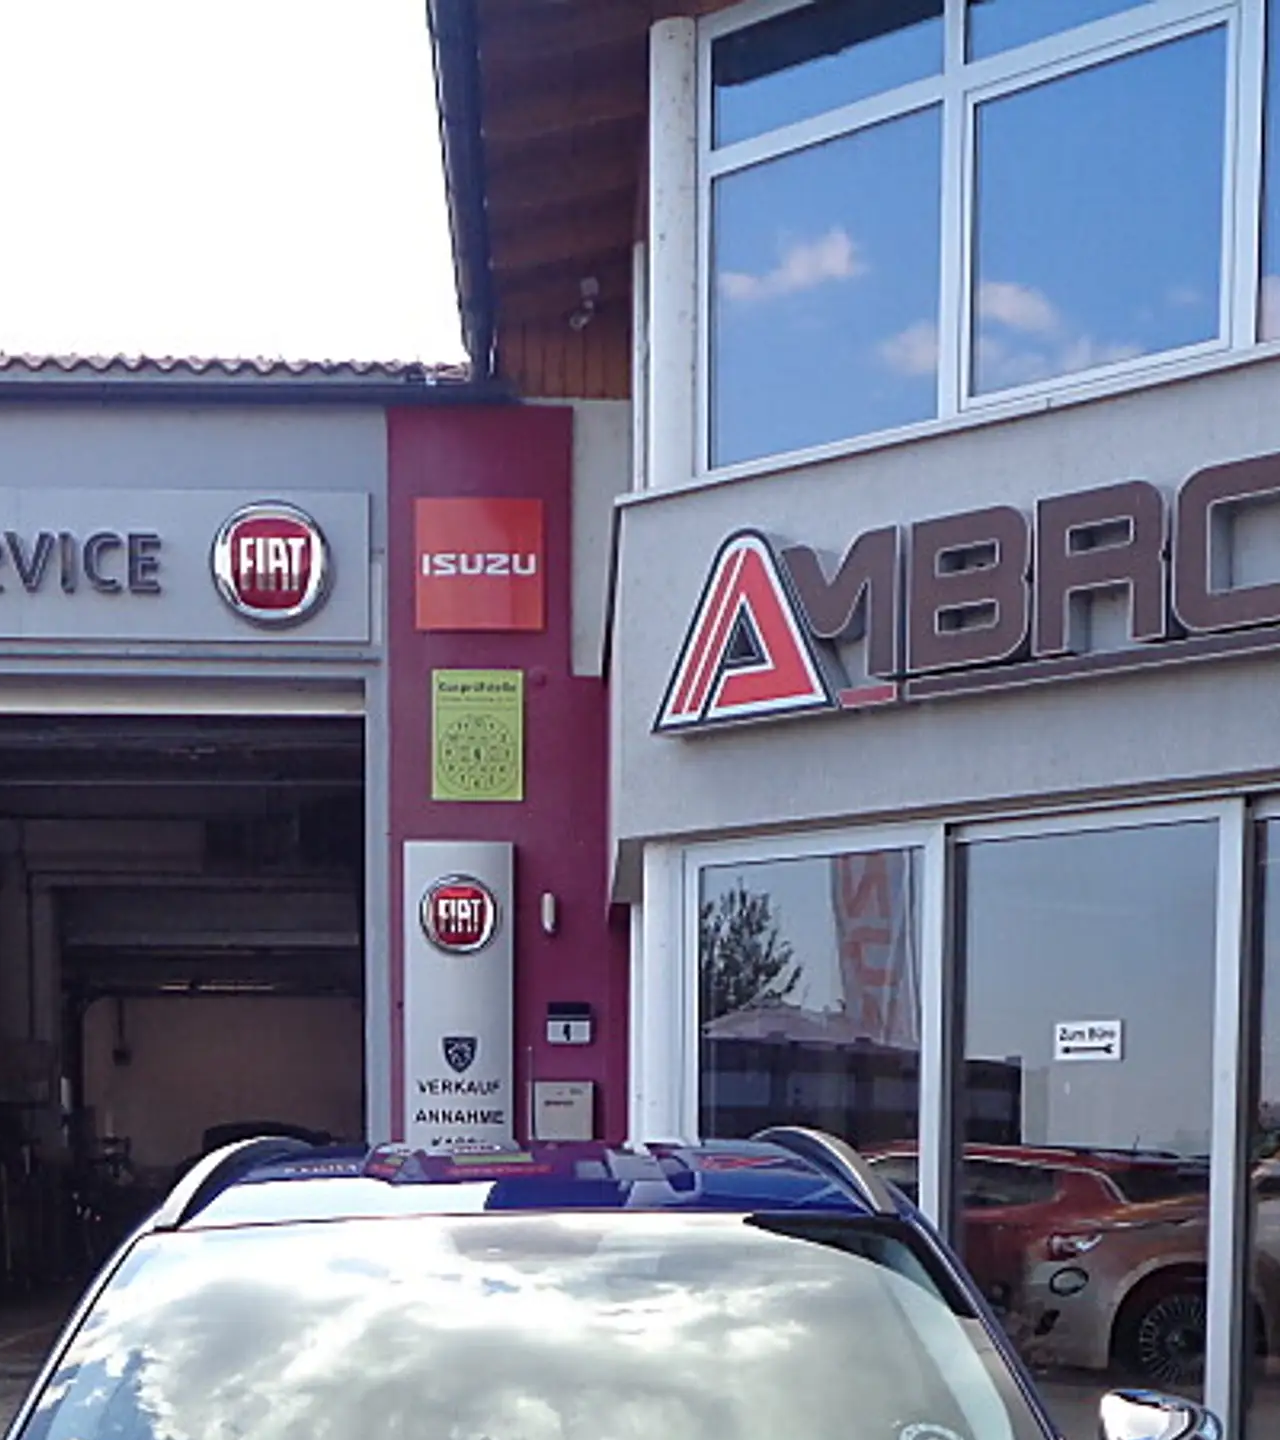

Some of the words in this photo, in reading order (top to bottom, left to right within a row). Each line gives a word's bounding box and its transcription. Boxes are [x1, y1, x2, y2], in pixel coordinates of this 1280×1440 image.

[240, 537, 307, 591] FIAT
[422, 553, 538, 576] ISUZU
[438, 898, 483, 933] FIAT
[1059, 1027, 1086, 1042] Zum
[417, 1078, 501, 1096] VERKAUF
[415, 1110, 505, 1125] ANNAHME
